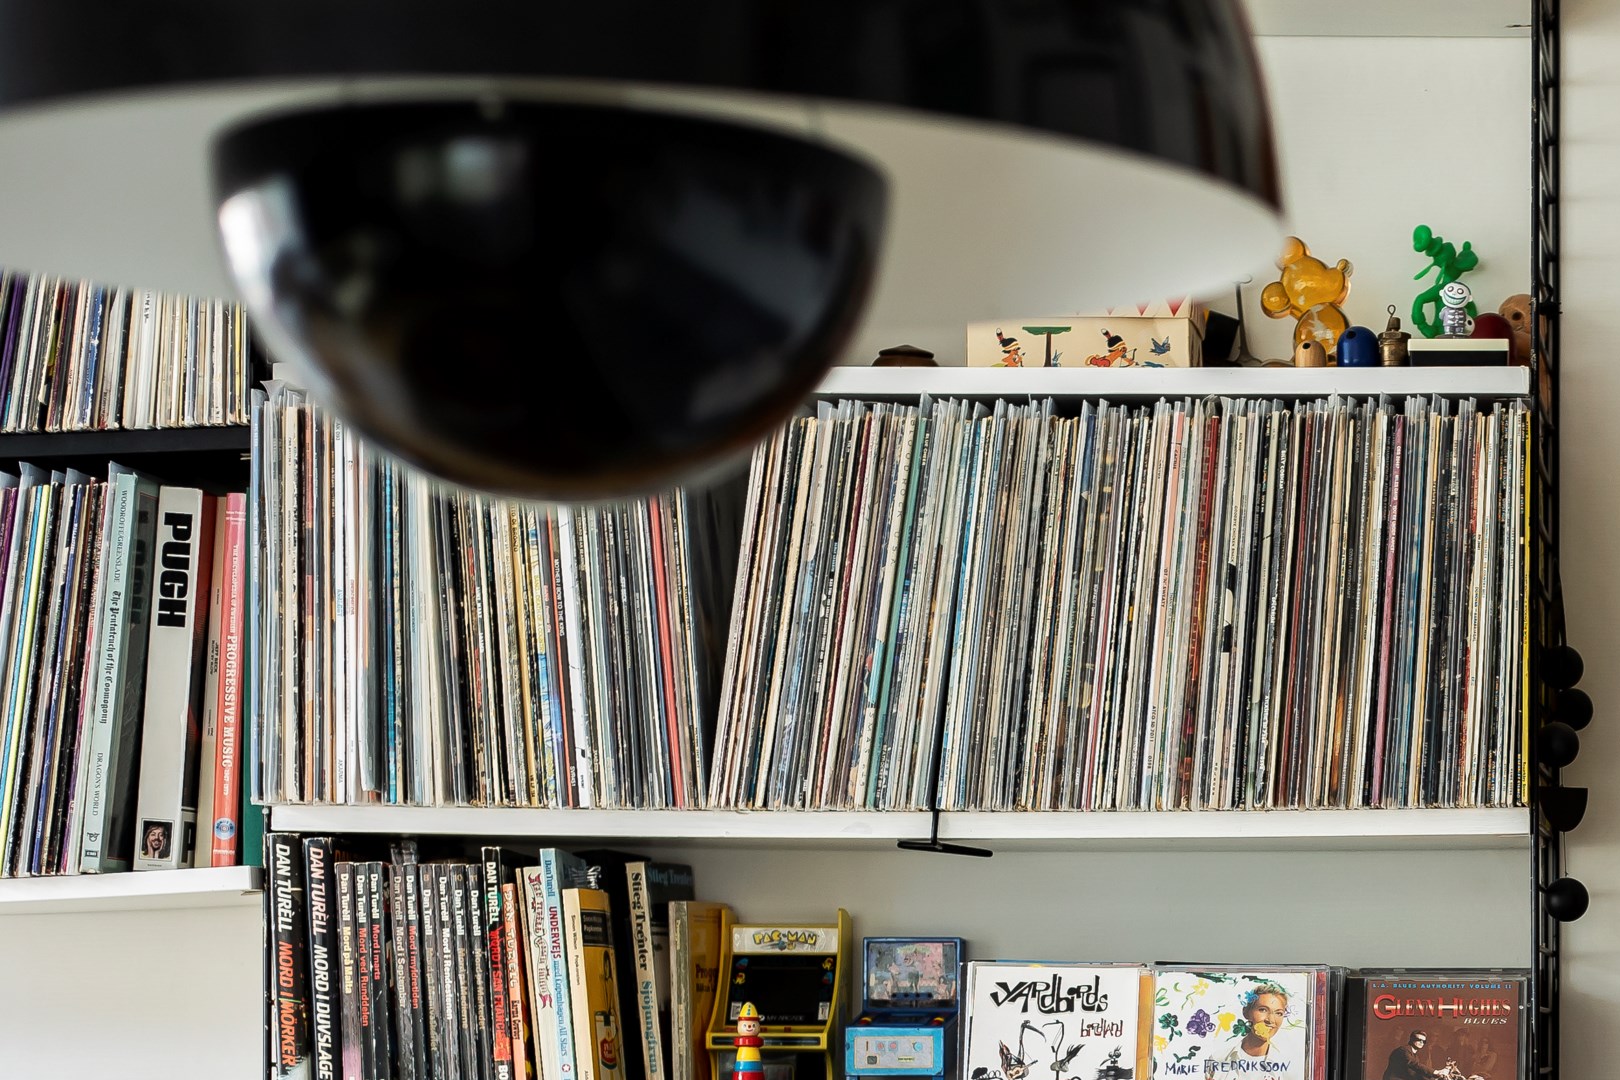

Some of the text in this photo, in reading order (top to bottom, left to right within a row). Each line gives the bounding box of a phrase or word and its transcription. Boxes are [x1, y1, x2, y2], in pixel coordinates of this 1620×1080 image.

[157, 511, 193, 628] PUGH
[557, 601, 563, 609] TO
[224, 635, 238, 723] PROGRESSIVE
[222, 726, 234, 768] MUSIC
[276, 843, 291, 876] DAN
[309, 846, 324, 879] DAN
[341, 873, 349, 893] Dan
[357, 875, 365, 894] Dan
[370, 873, 379, 892] Dan
[394, 876, 402, 894] Dan
[406, 875, 414, 894] Dan
[439, 876, 447, 895] Dan
[486, 862, 497, 884] DAN
[423, 889, 431, 908] Dan
[455, 889, 463, 908] Dan
[471, 889, 479, 908] Dan
[631, 872, 642, 910] Stieg
[504, 890, 514, 922] DAN
[359, 927, 367, 953] Mord
[372, 924, 381, 949] Mord
[397, 926, 405, 951] Mord
[408, 925, 417, 952] Mord
[442, 927, 451, 954] Mord
[548, 906, 562, 960] UNDERVEJS
[753, 929, 818, 945] PAC-MAN
[279, 941, 294, 988] MORD
[313, 944, 330, 992] MORD
[361, 975, 370, 1027] Runddelen
[554, 978, 564, 1024] Copenhagen
[1373, 993, 1512, 1020] GLENN HUGHES
[1463, 1017, 1508, 1025] BLUES
[1165, 1058, 1291, 1076] MARIE FREDRIKSSON
